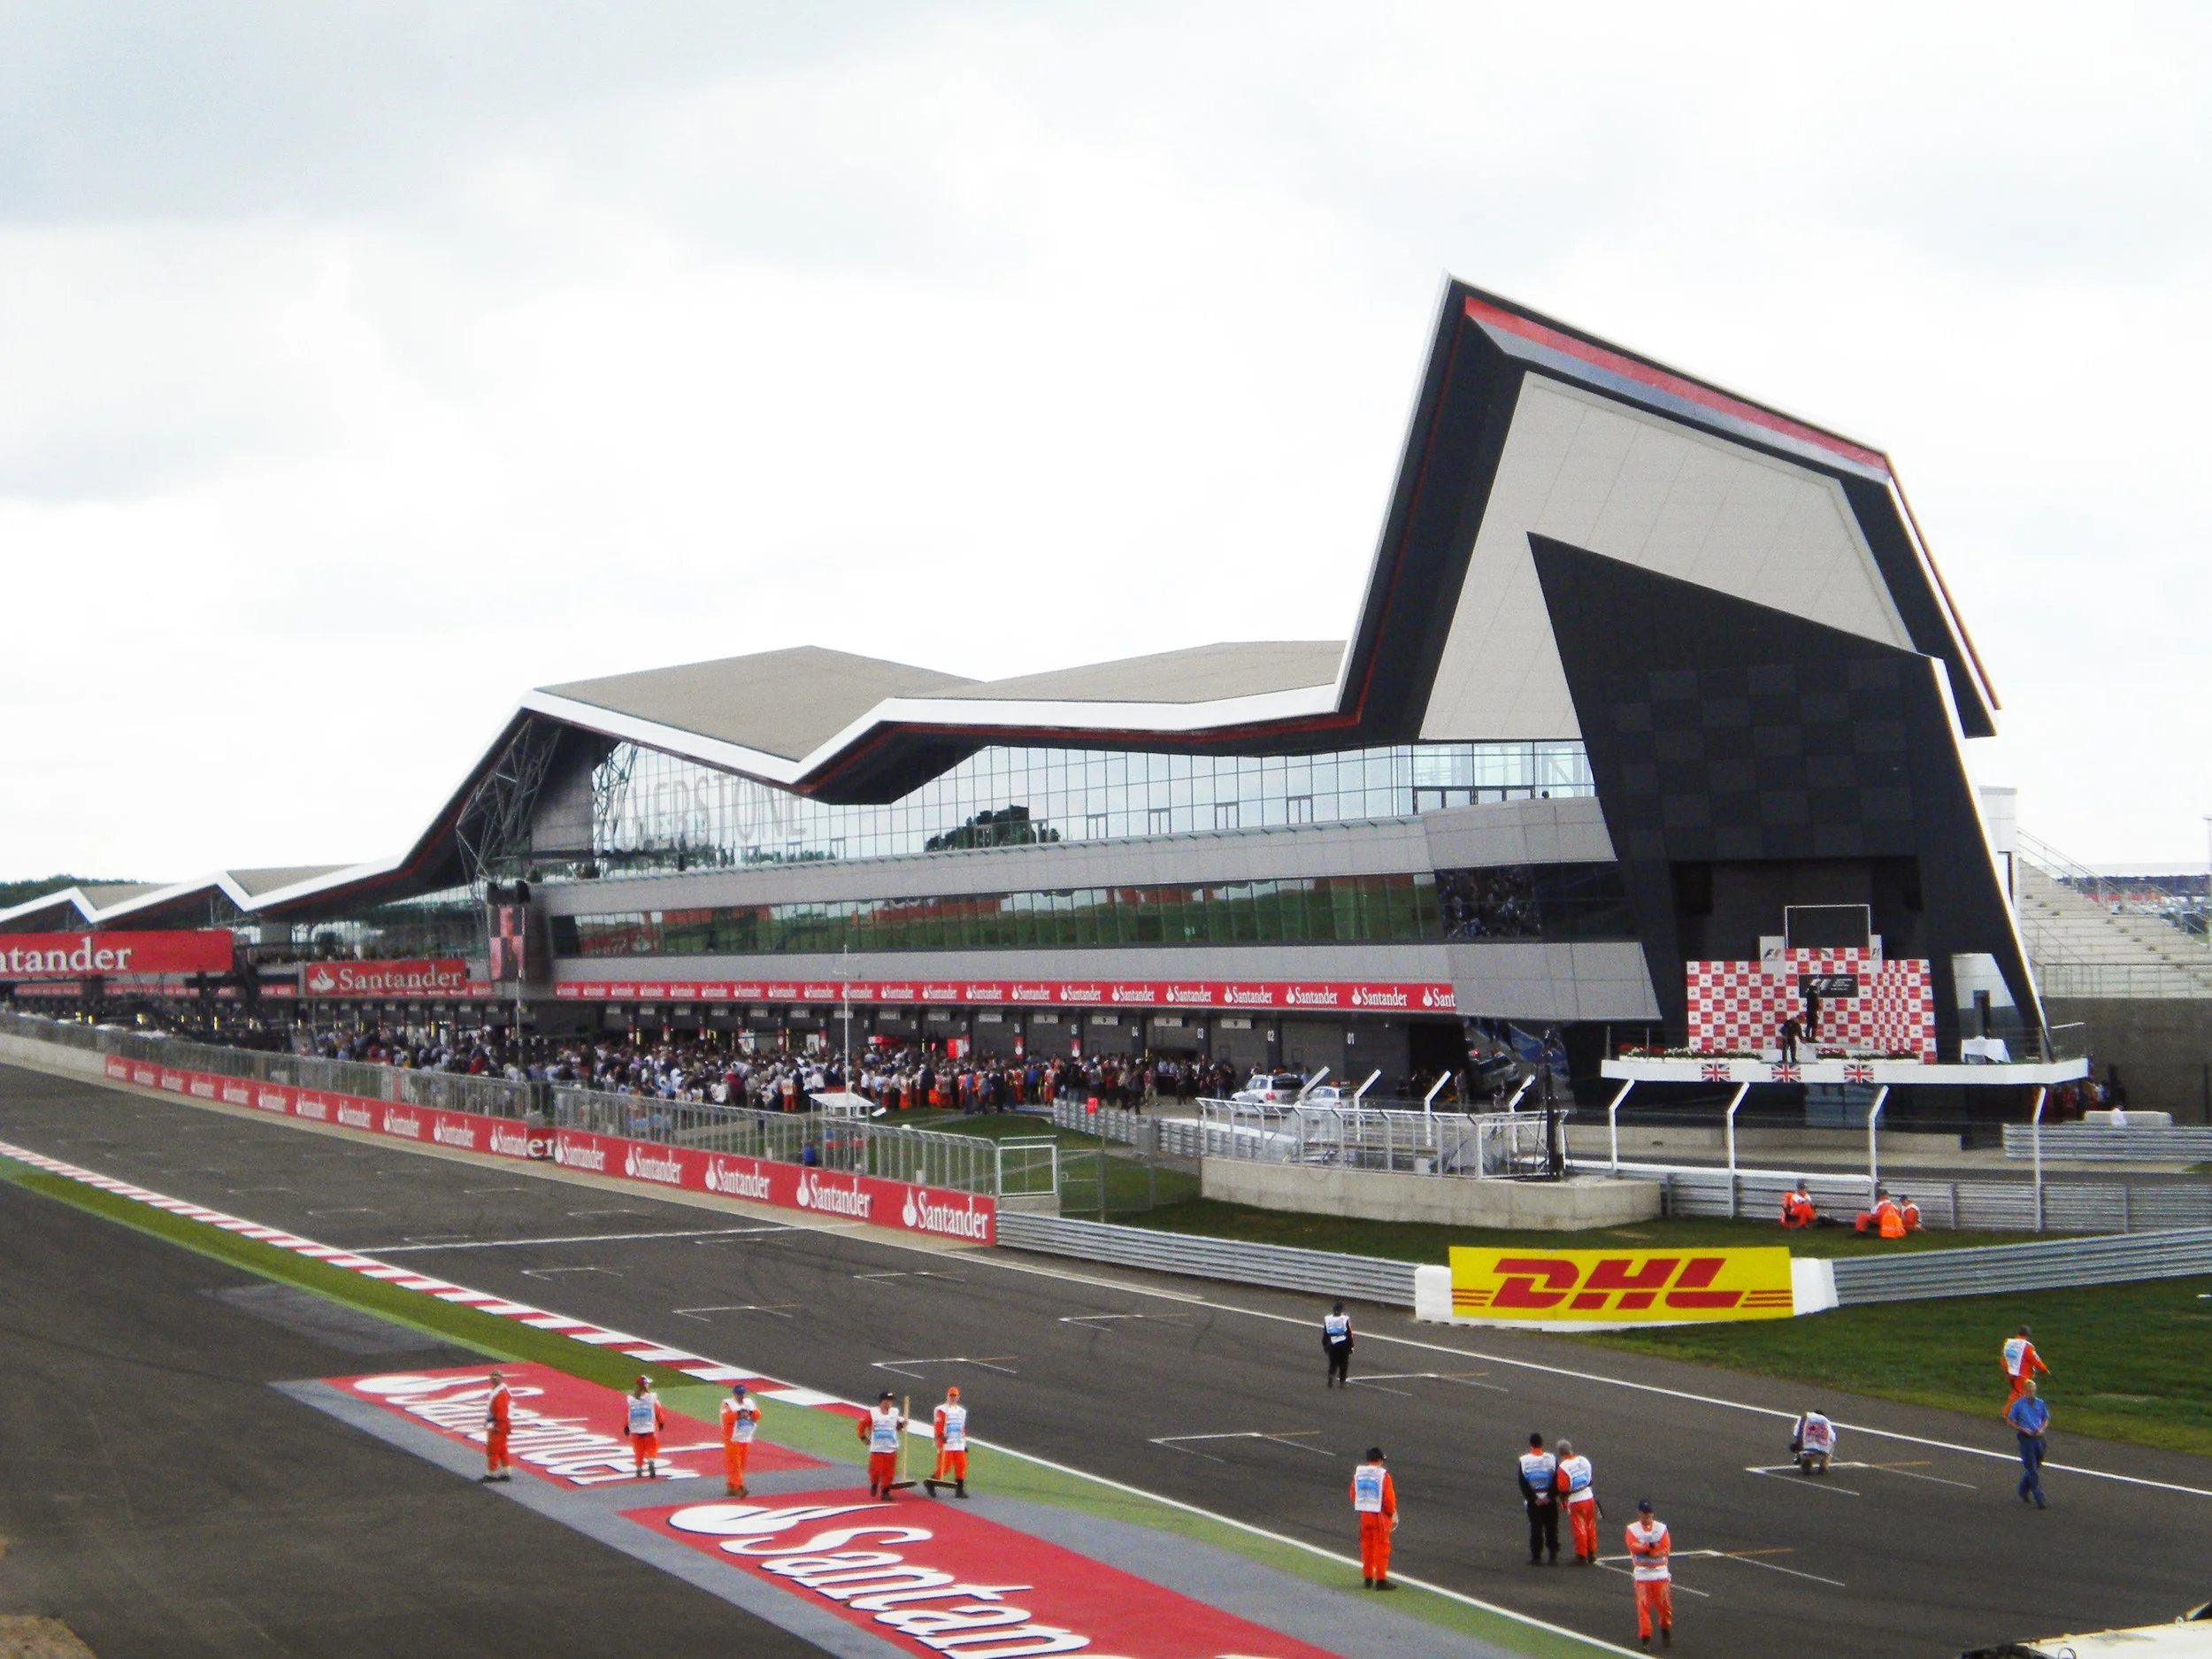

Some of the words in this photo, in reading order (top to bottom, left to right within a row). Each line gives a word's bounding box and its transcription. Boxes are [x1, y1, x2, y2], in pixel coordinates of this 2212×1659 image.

[339, 964, 462, 991] Santander
[1068, 985, 1102, 1001] Santander
[1119, 985, 1155, 1002] Santander
[1174, 985, 1211, 1002] Santander
[1233, 986, 1272, 1003] Santander
[1295, 987, 1338, 1005] Santander
[1362, 987, 1407, 1007] Santander
[1433, 988, 1455, 1007] Sant
[1267, 1030, 1275, 1041] 02
[1347, 1033, 1355, 1045] 01
[564, 1136, 604, 1171] Santander
[634, 1147, 682, 1184] Santander
[716, 1158, 771, 1199] Santander
[809, 1173, 871, 1218] Santander
[918, 1190, 988, 1240] Santander
[1490, 1257, 1743, 1310] DHL
[718, 1526, 1141, 1659] Santan
